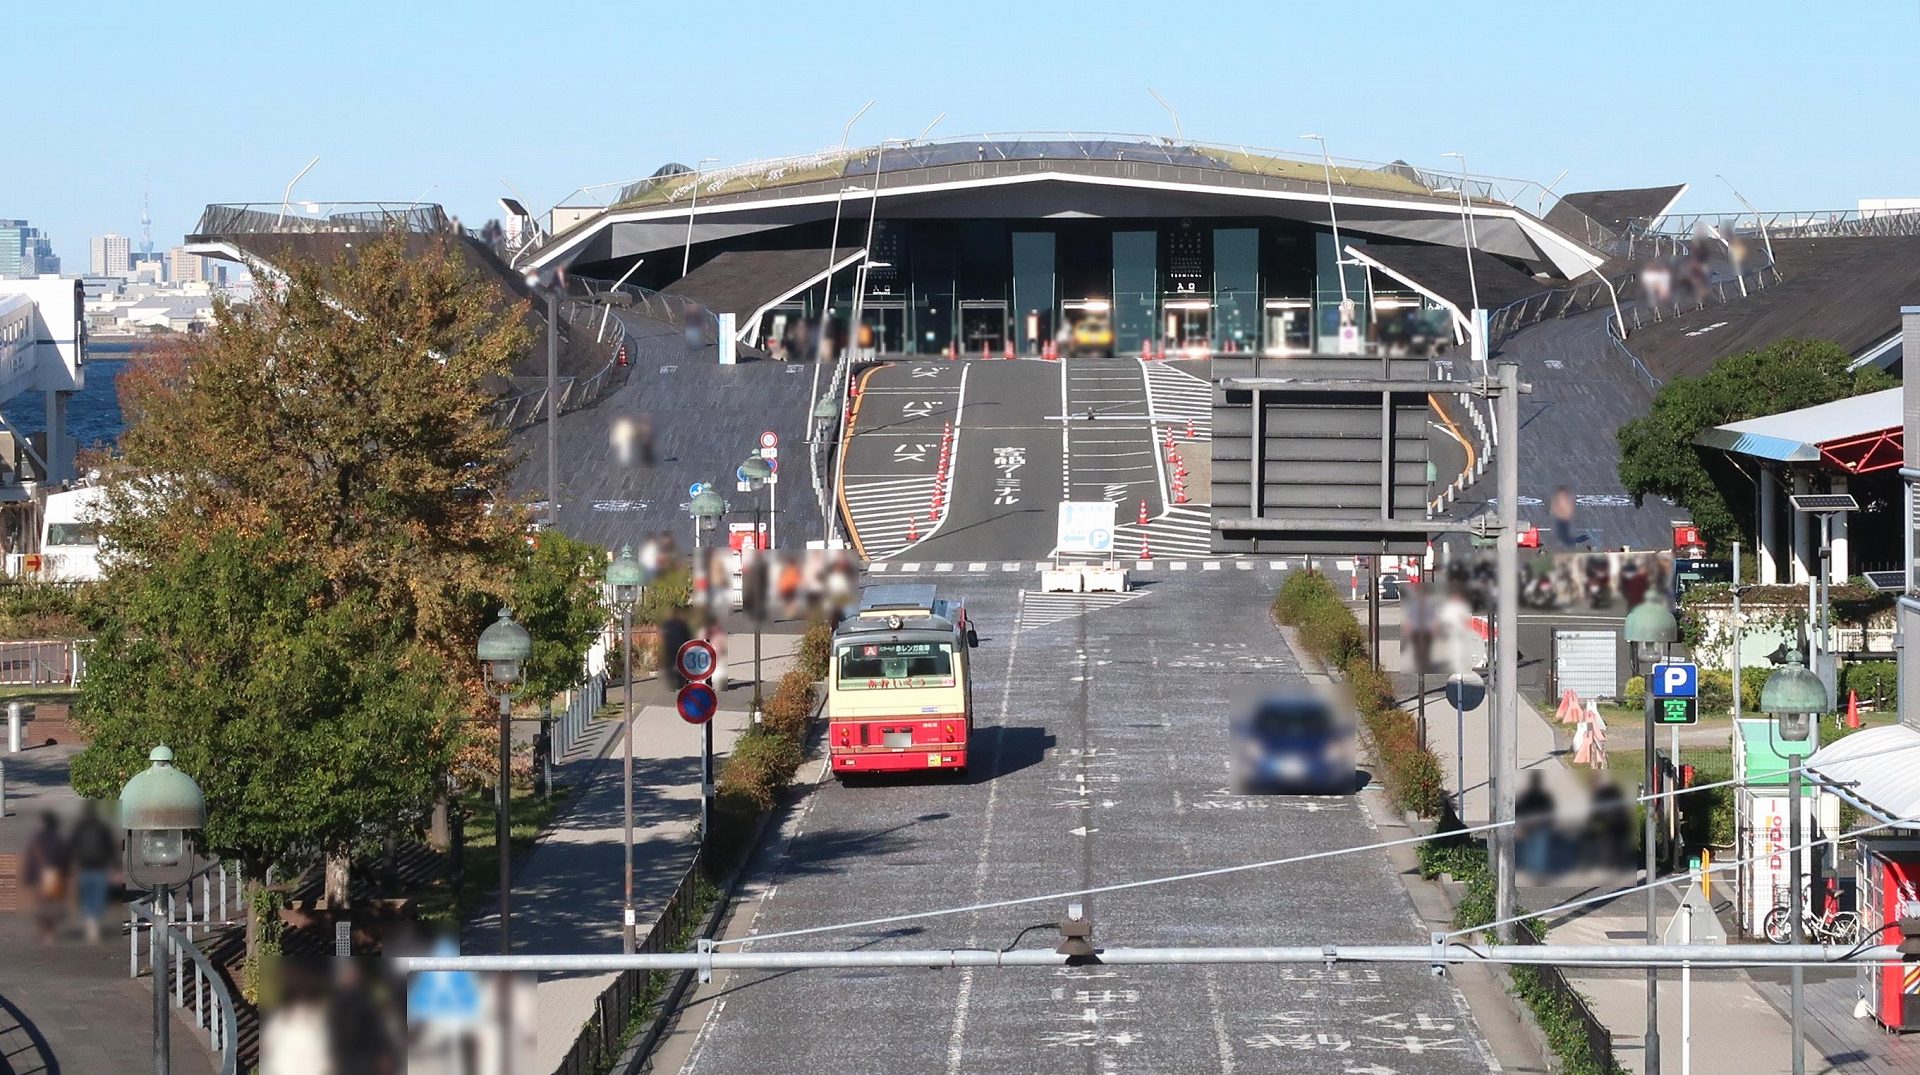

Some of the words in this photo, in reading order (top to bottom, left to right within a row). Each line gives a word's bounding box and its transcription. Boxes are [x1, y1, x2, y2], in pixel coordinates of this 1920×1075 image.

[1177, 282, 1195, 290] 入口
[912, 367, 949, 378] バス
[902, 401, 943, 417] バス
[893, 443, 937, 462] バス
[685, 652, 709, 670] 30
[1664, 667, 1687, 694] P
[1663, 699, 1687, 721] 空
[1770, 815, 1785, 870] DyDo
